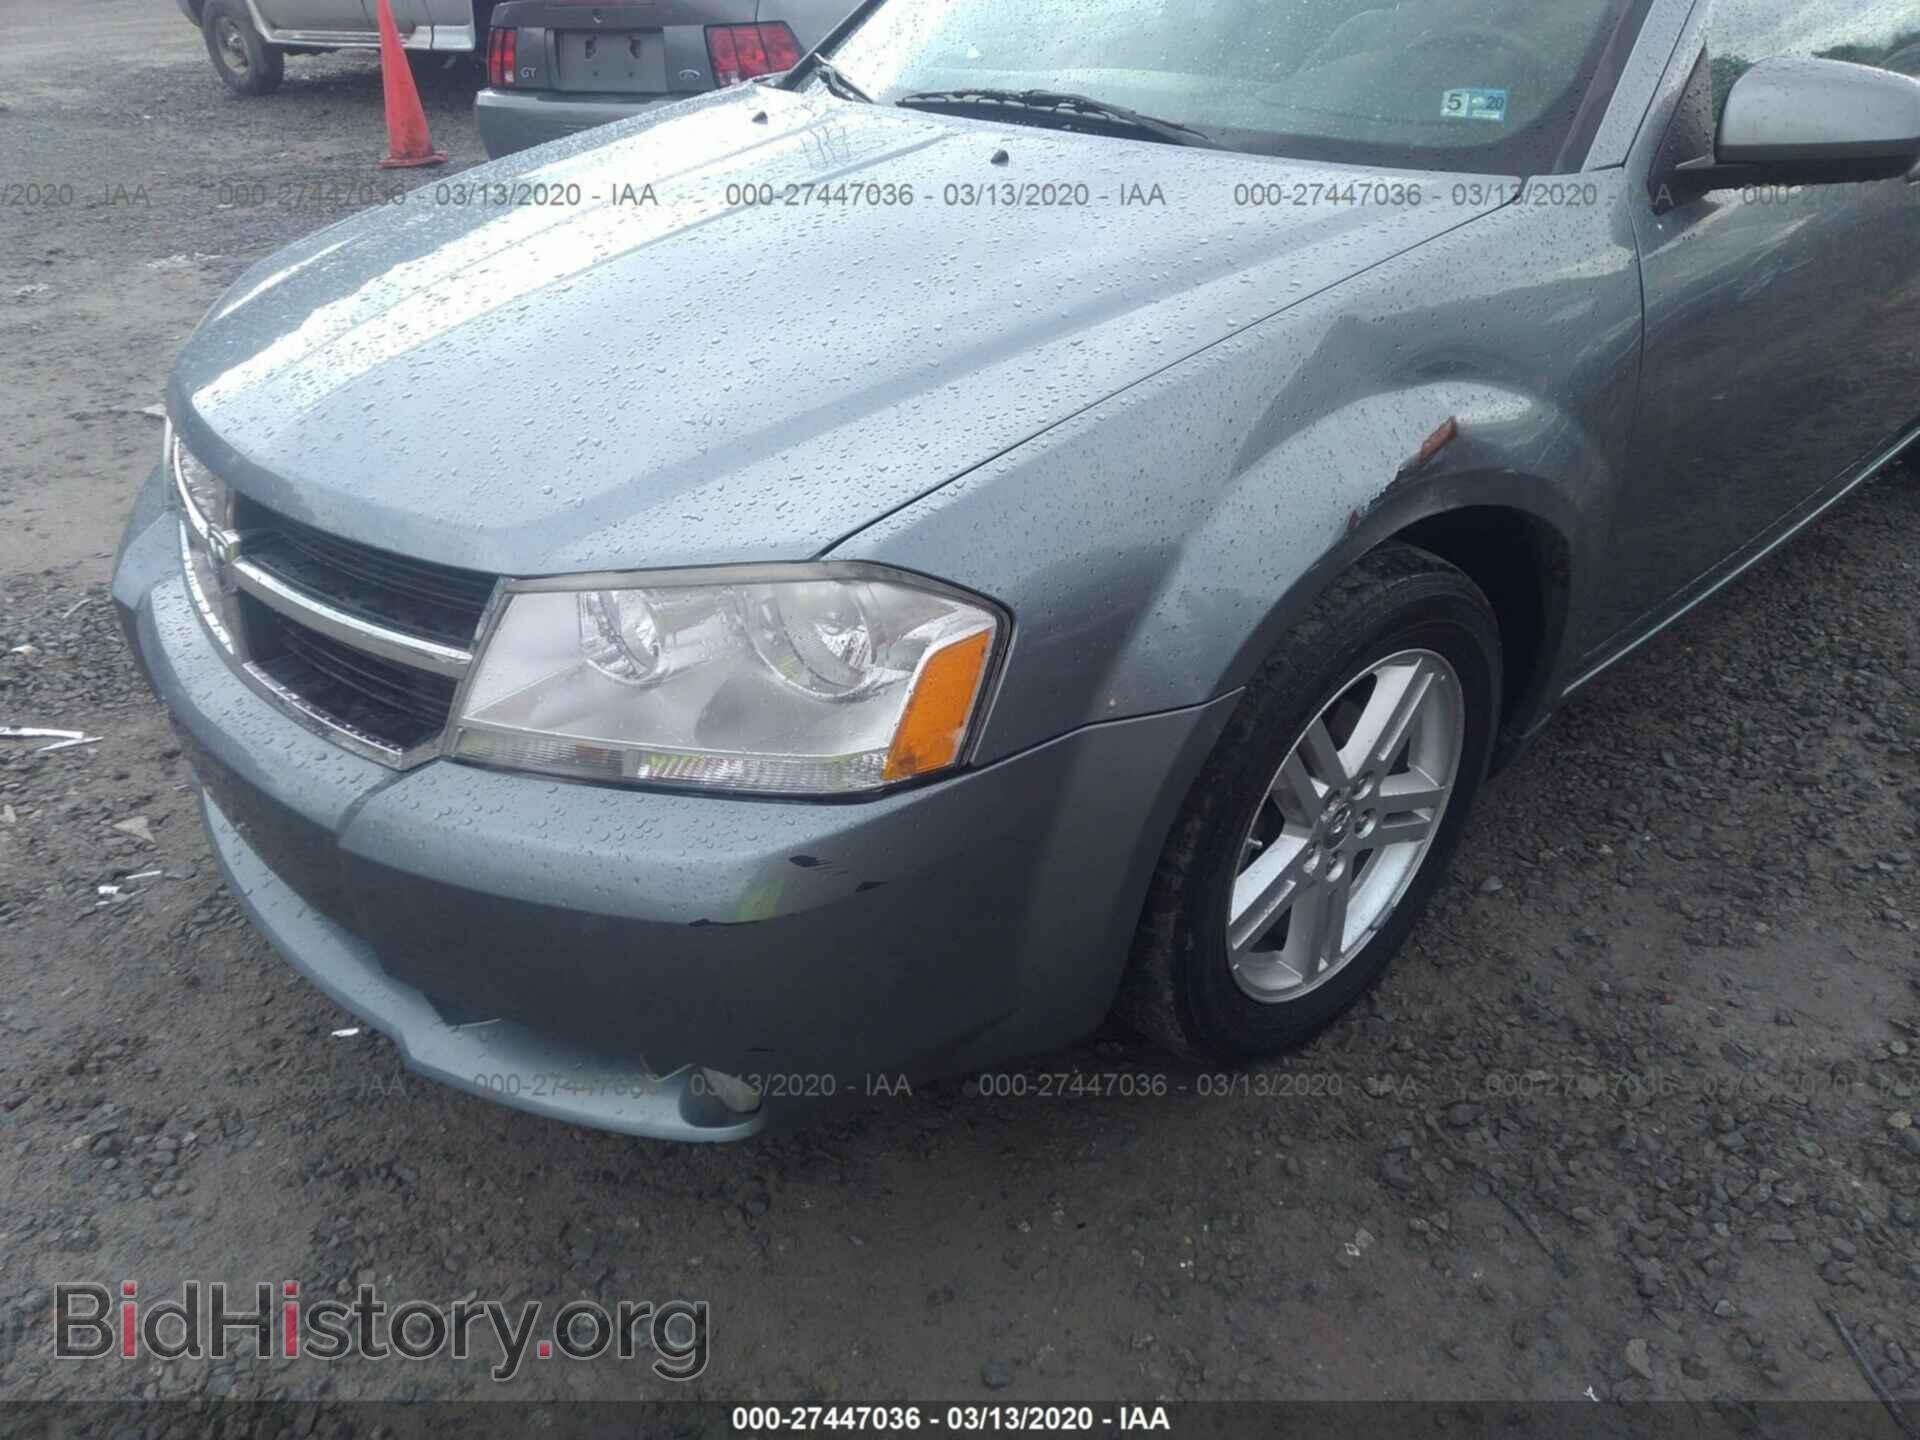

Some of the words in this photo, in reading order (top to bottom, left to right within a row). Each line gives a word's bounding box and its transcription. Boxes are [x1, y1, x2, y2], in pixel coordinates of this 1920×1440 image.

[520, 66, 537, 80] GT
[1447, 94, 1462, 110] 5
[1486, 95, 1505, 111] 20
